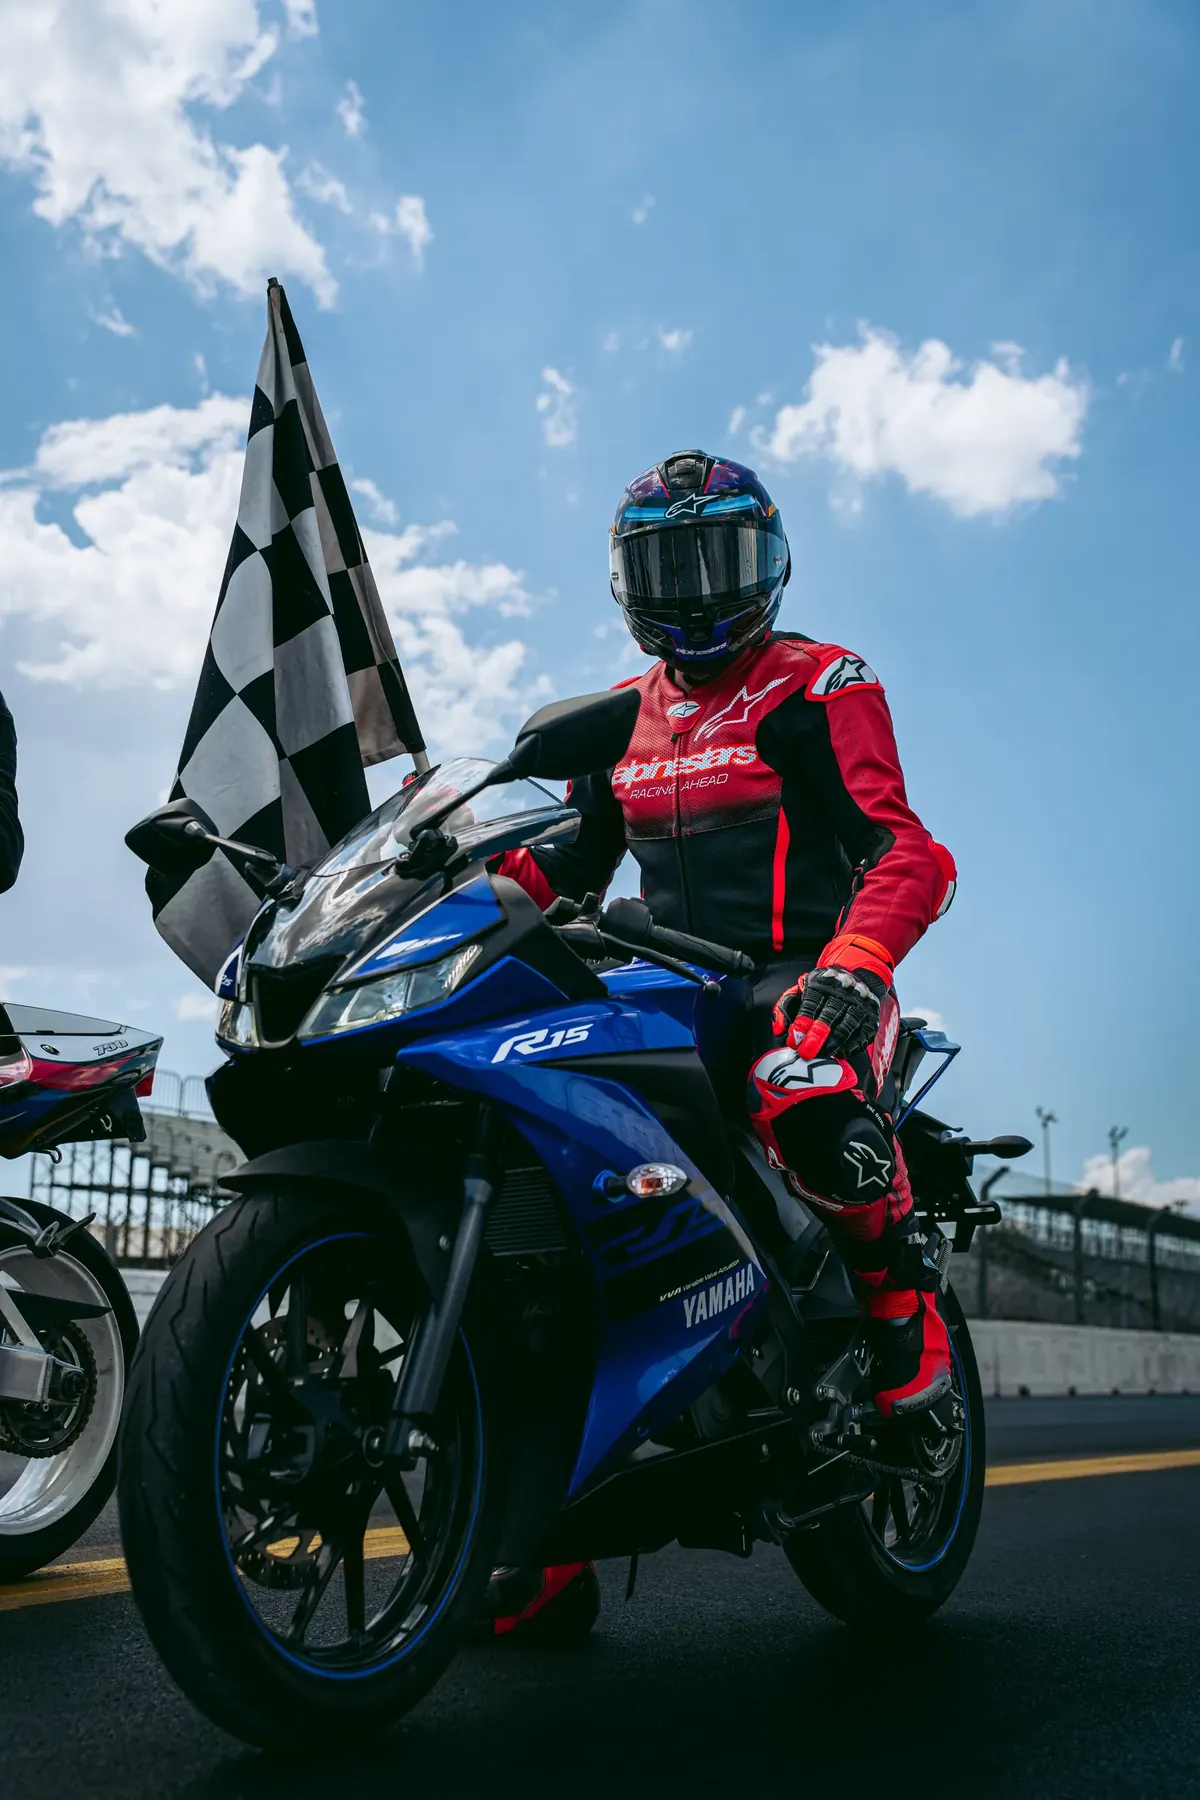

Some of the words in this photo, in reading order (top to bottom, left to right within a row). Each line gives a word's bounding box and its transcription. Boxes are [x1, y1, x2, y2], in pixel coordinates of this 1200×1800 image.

[629, 782, 677, 799] RACING
[680, 773, 729, 792] AHEAD
[93, 1039, 129, 1056] 750
[491, 1023, 594, 1064] R15
[683, 1262, 755, 1329] YAMAHA
